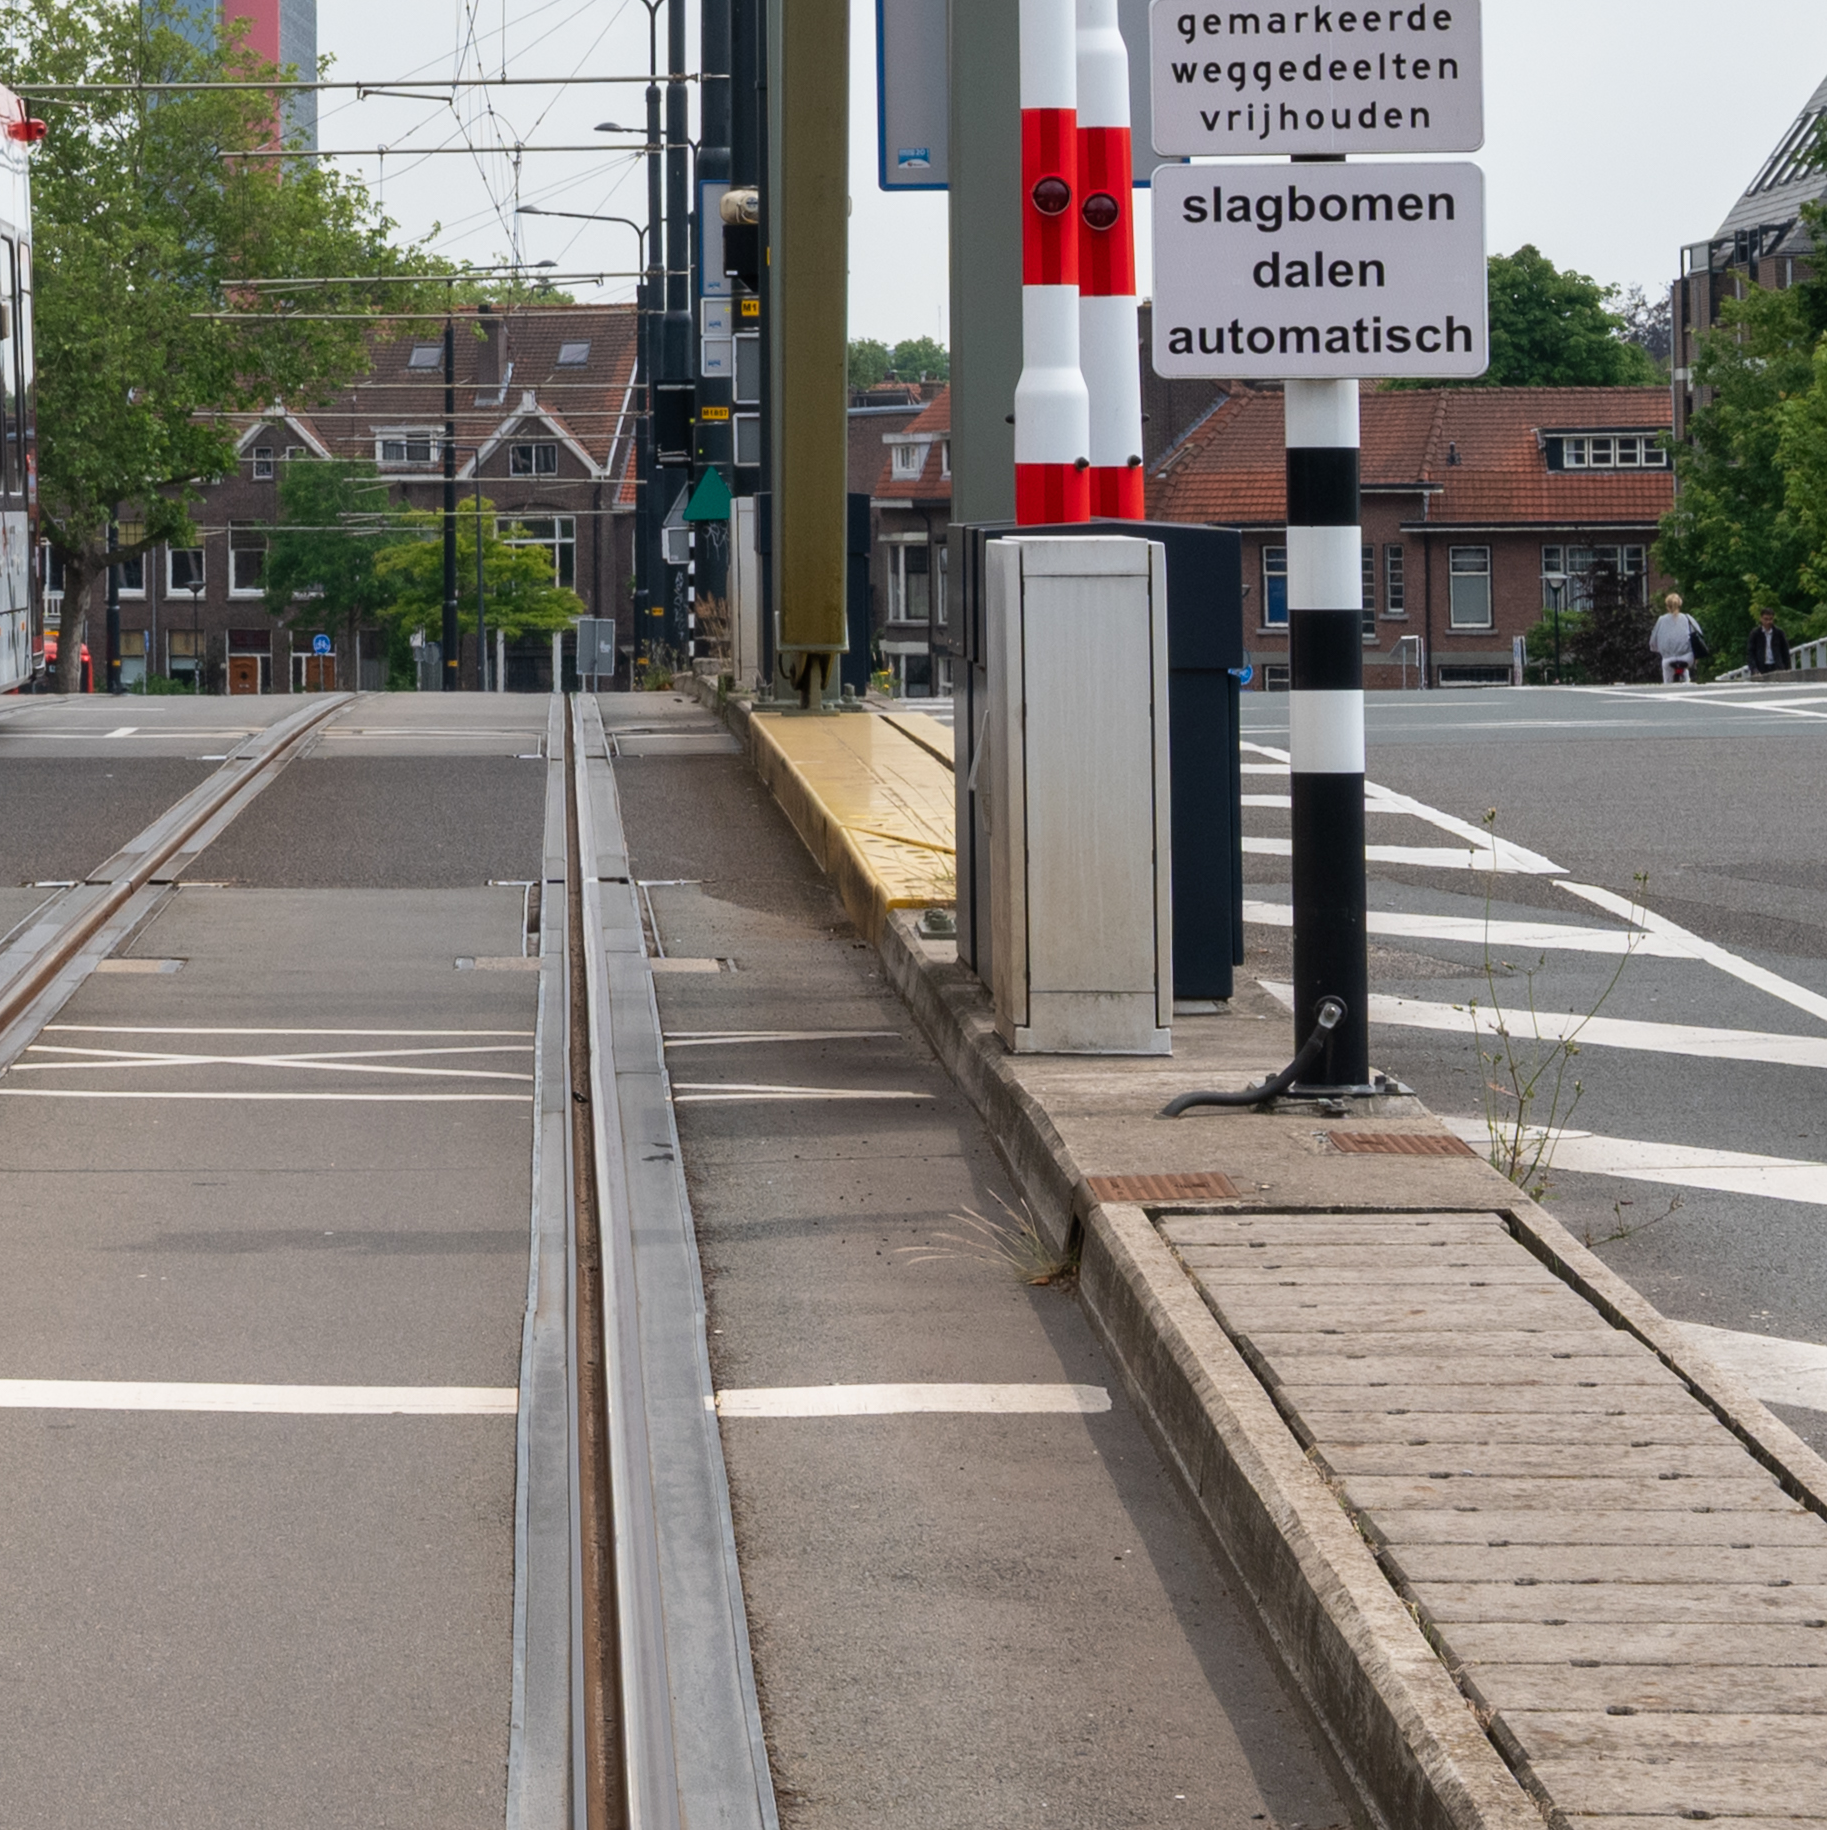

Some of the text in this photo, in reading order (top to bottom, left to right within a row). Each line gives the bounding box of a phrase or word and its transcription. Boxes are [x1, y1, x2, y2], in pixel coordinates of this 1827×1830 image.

[1177, 2, 1452, 45] gemarkeerde
[1171, 52, 1459, 92] weggedeelten
[1199, 101, 1431, 140] vrijhouden
[1182, 185, 1455, 233] slagbomen
[1253, 251, 1386, 288] dalen
[1168, 316, 1473, 355] automatisch
